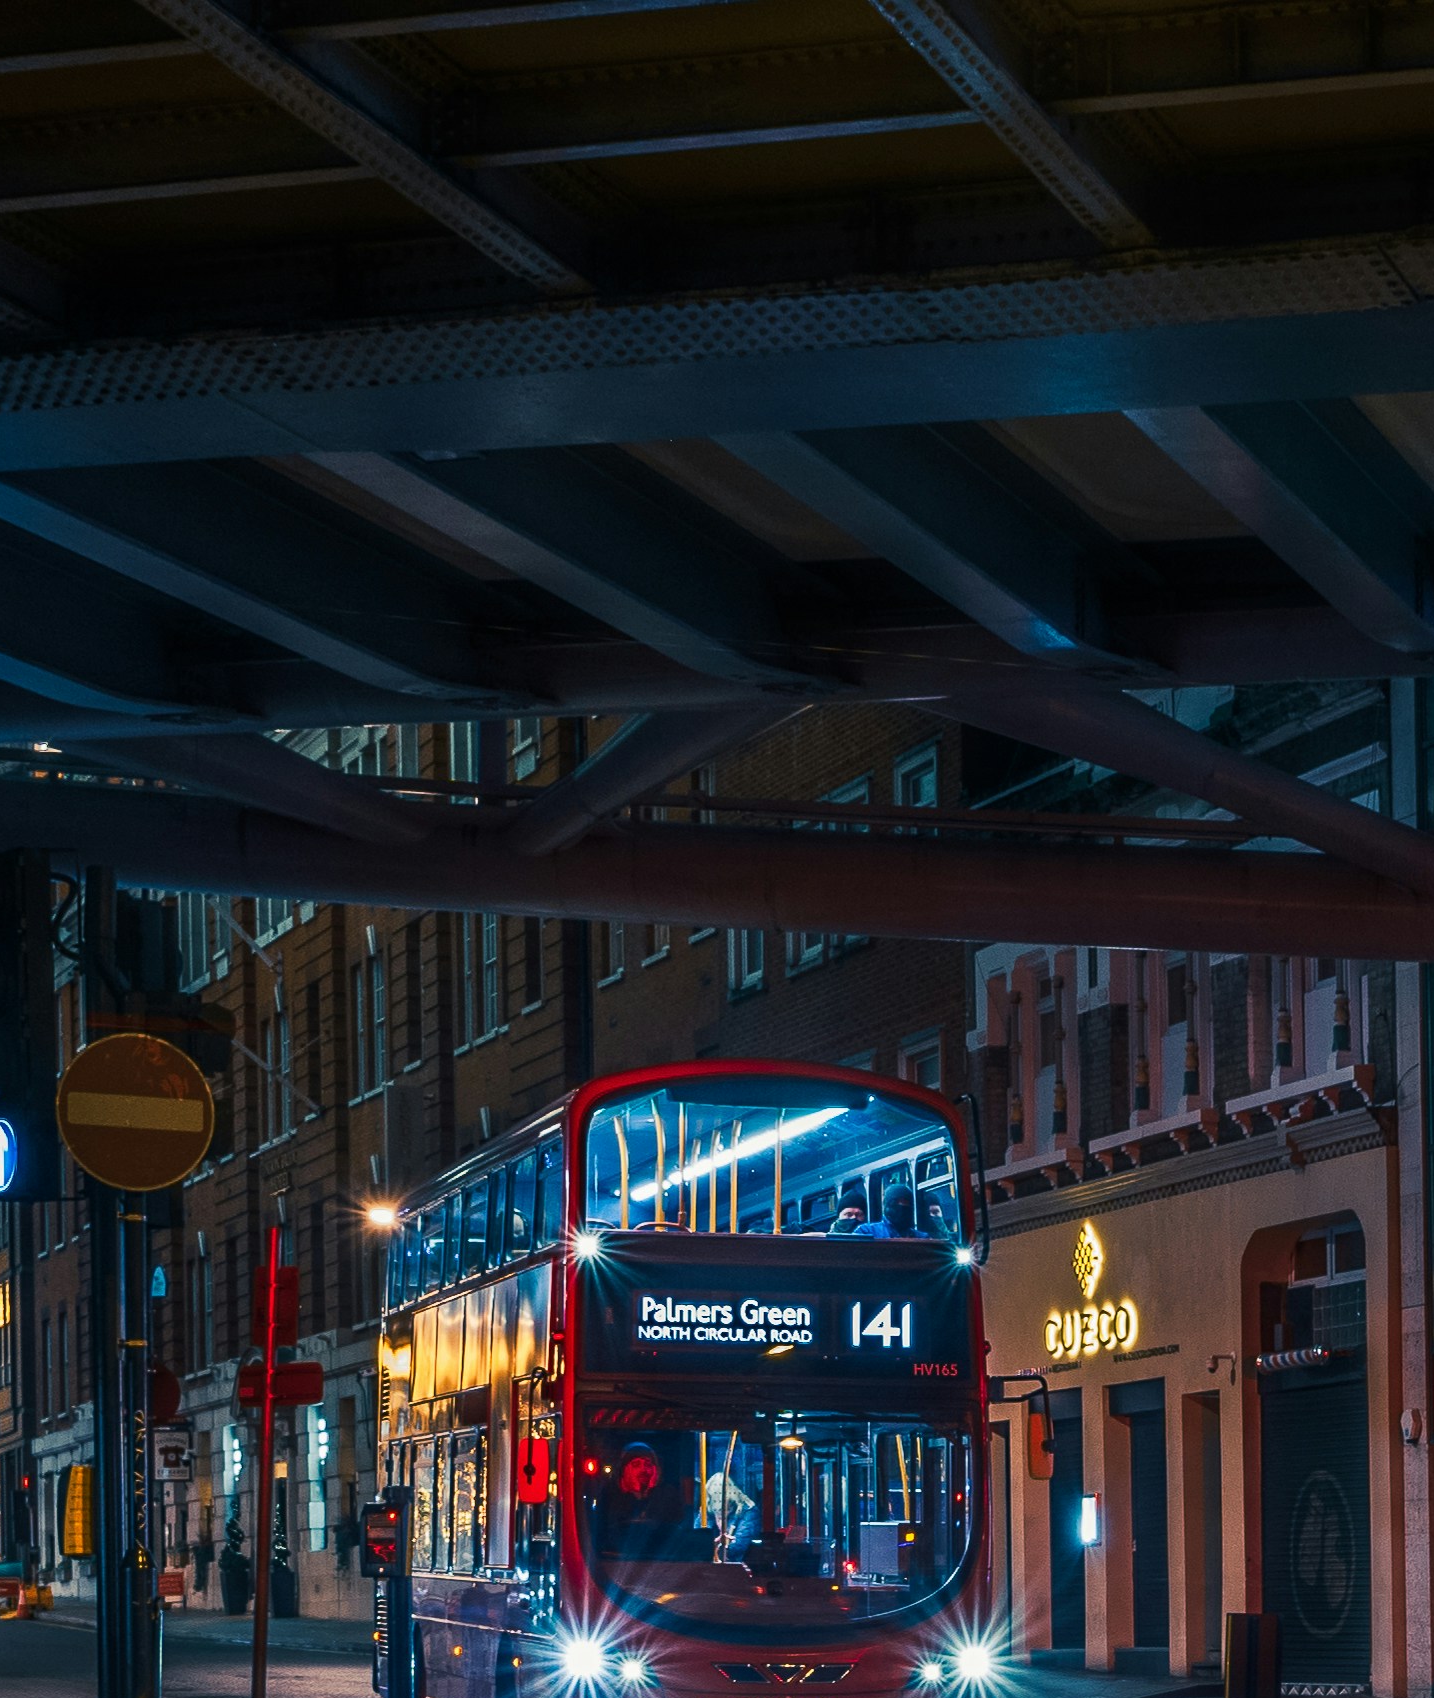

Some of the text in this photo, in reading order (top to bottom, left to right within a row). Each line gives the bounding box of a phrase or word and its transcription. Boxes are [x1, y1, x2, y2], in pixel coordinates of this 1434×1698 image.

[642, 1297, 811, 1326] Palmers Green
[638, 1326, 813, 1344] NORTH CIRCULAR ROAD
[851, 1301, 912, 1348] 141
[913, 1363, 959, 1377] HV165
